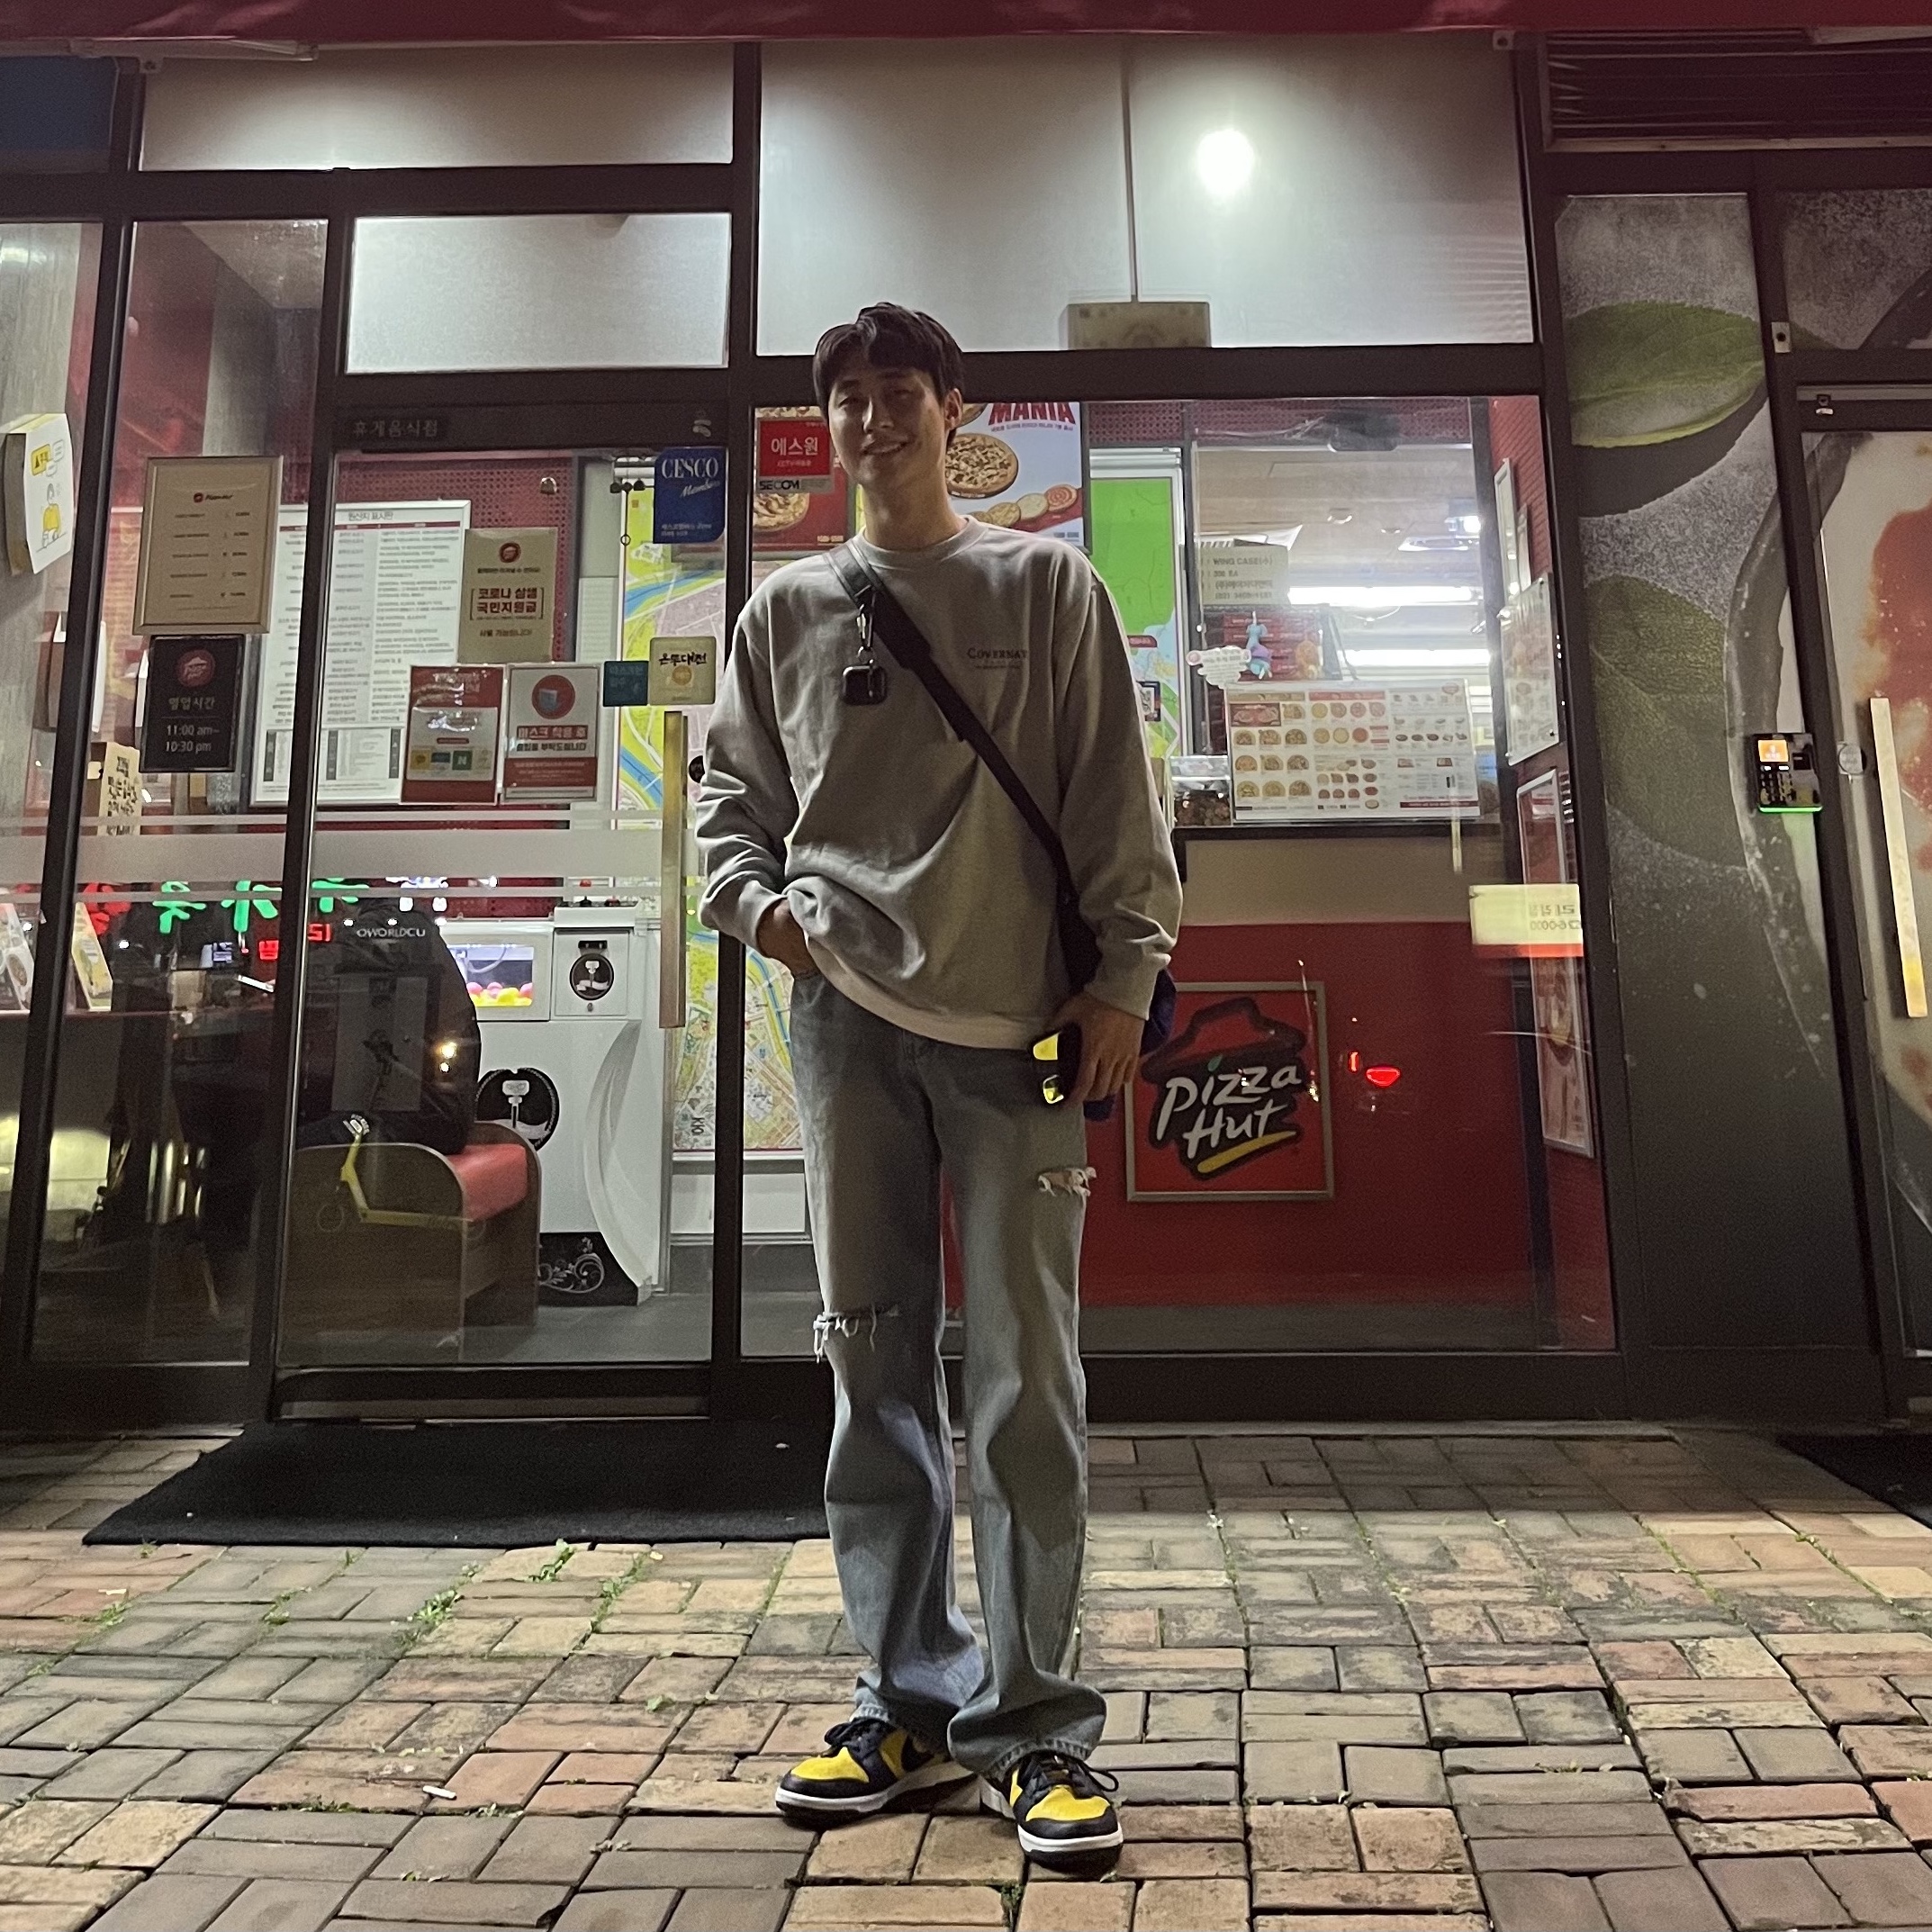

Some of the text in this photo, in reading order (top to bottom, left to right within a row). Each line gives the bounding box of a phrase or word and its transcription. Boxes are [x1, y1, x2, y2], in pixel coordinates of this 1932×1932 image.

[989, 403, 1076, 426] MANIA
[771, 437, 818, 456] 에스원
[662, 457, 718, 479] CESCO
[759, 480, 799, 490] SECOM
[478, 588, 511, 600] 코로나
[477, 601, 537, 613] 국민지원금
[168, 697, 215, 710] 영업시간
[167, 724, 195, 736] 11:00
[518, 727, 549, 739] 마스크
[166, 740, 212, 754] 10:30 pm
[1157, 1055, 1303, 1142] Pizza
[1182, 1098, 1288, 1160] Hut
